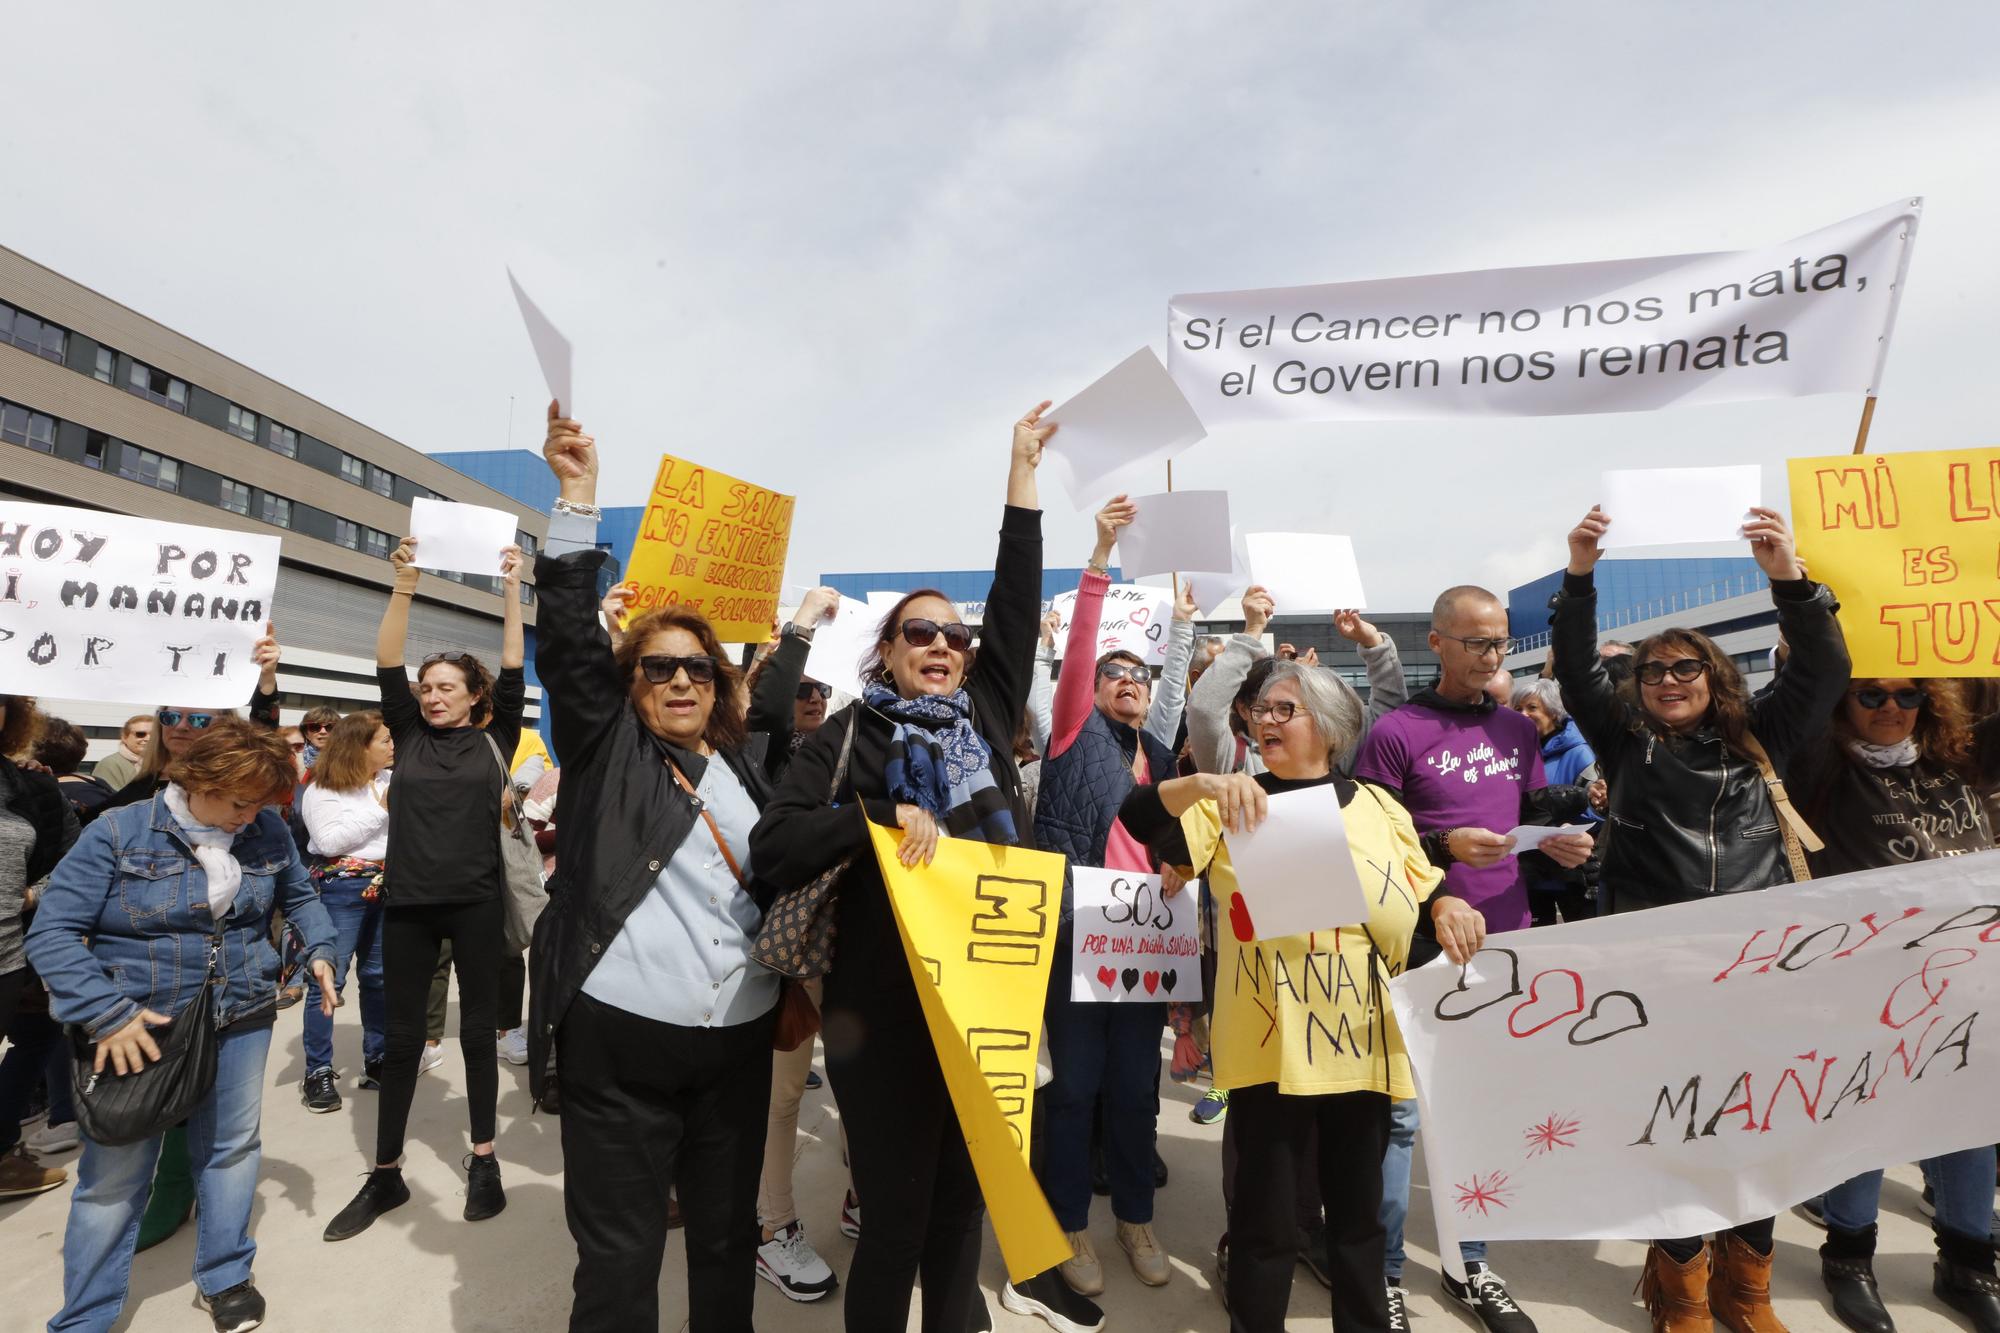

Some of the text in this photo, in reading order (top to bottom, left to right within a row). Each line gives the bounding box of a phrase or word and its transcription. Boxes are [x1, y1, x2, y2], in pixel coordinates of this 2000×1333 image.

[1183, 253, 1867, 351] Sí el Cancer no nos mata,
[1220, 324, 1789, 397] el Govern nos remata
[655, 459, 704, 509] LA
[643, 505, 690, 547] NO
[0, 521, 253, 586] HOY POR
[669, 554, 698, 577] DE
[1903, 546, 1958, 586] ES
[60, 579, 262, 622] MAÑANA
[162, 642, 233, 680] TI
[1467, 742, 1494, 764] vida
[1463, 766, 1479, 784] es
[967, 873, 1047, 966] MI
[1112, 936, 1134, 955] UNA
[1713, 905, 2000, 984] HOY P
[1627, 1012, 1979, 1147] MAÑANA
